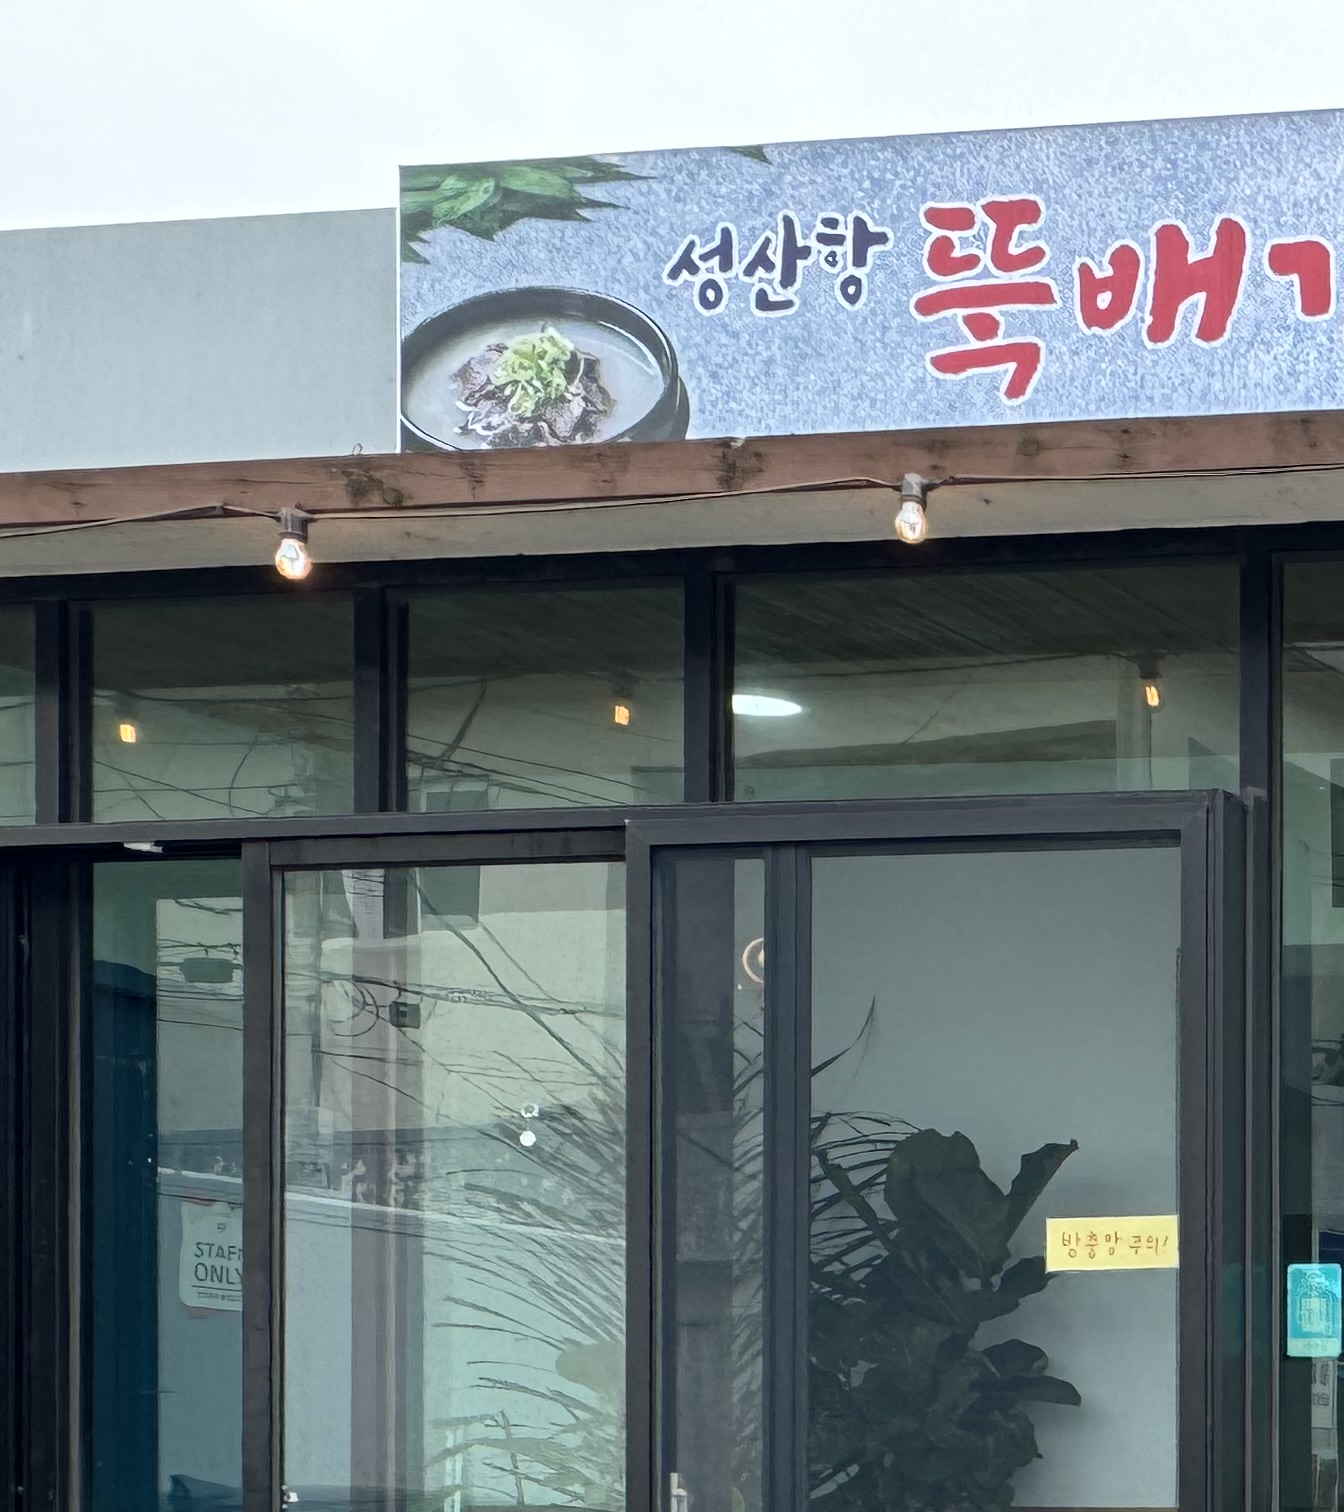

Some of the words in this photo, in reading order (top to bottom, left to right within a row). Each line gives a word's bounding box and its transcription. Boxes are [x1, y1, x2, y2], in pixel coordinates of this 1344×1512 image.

[665, 211, 891, 313] 성산항
[1061, 1231, 1122, 1259] 방충망
[1129, 1235, 1169, 1255] 주의!
